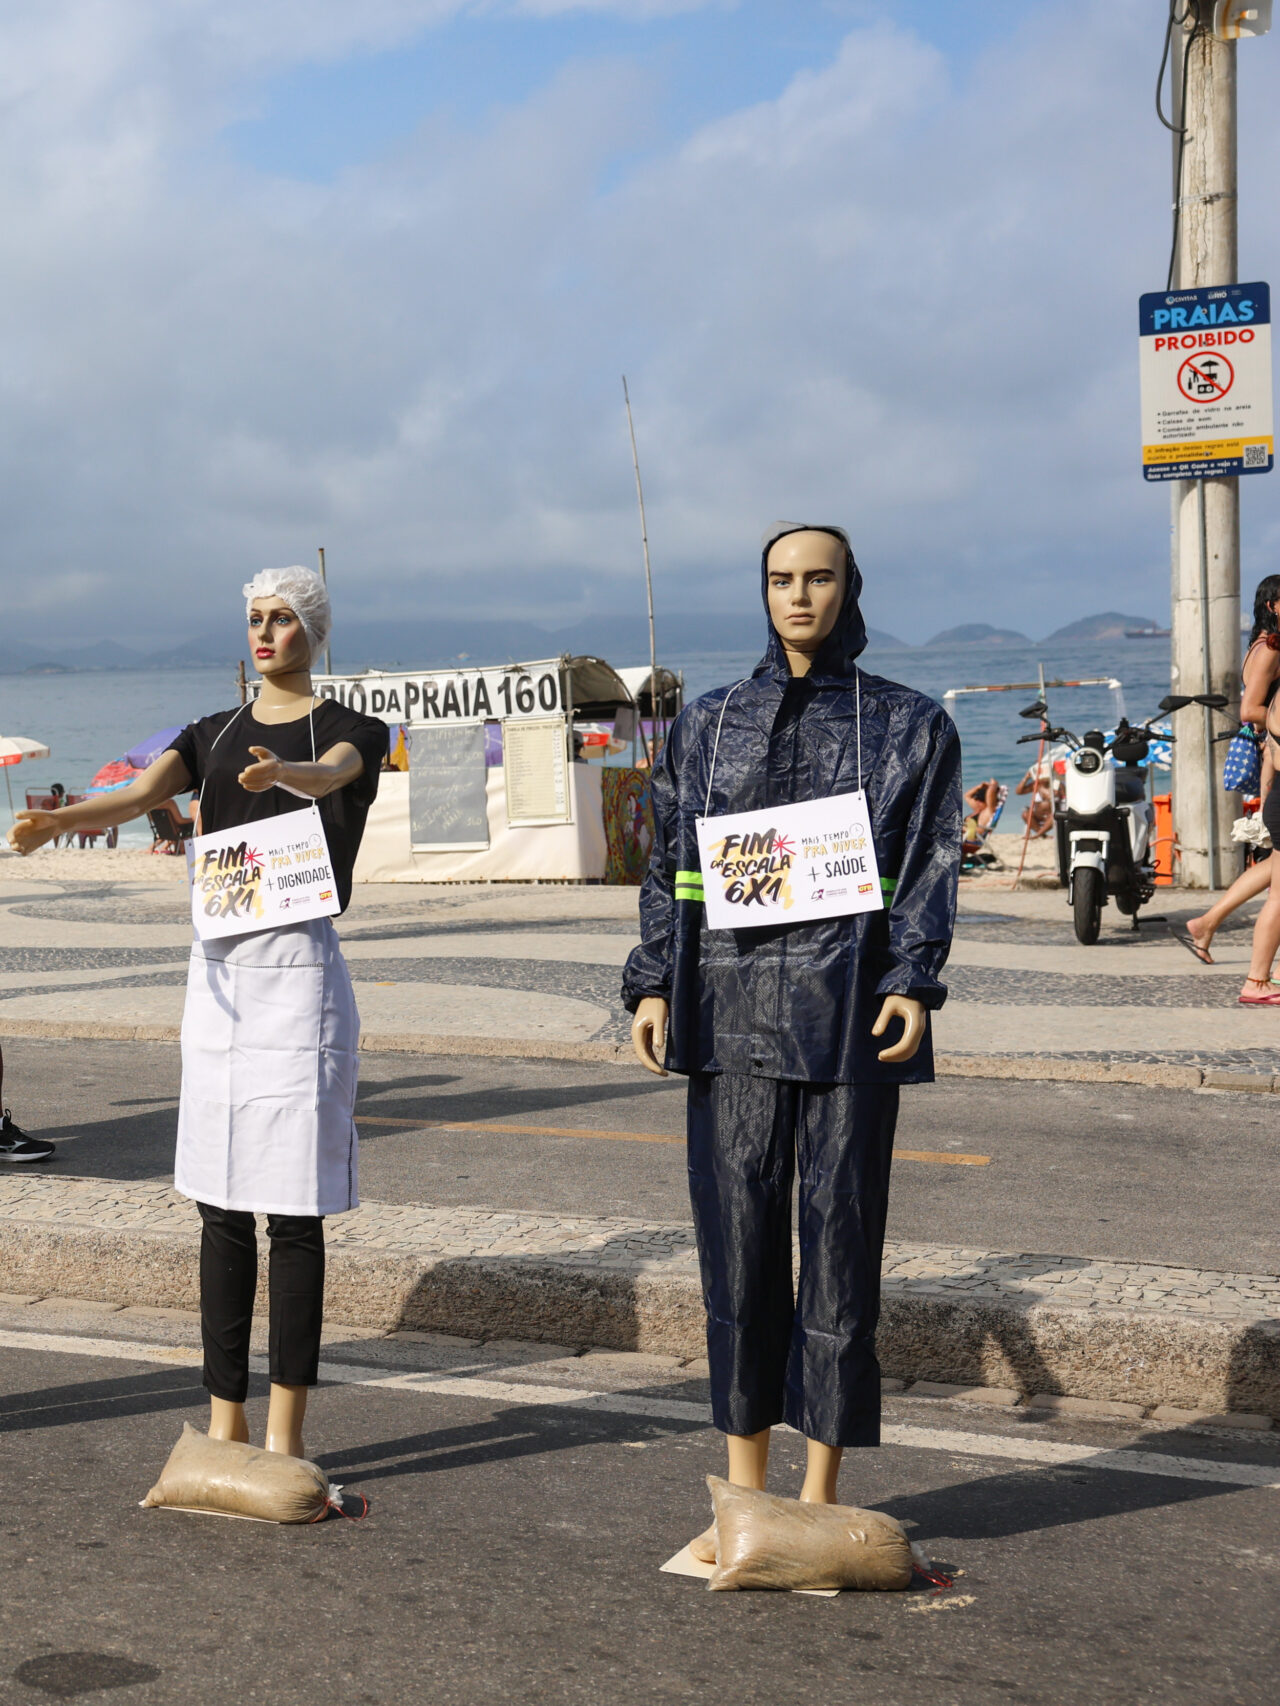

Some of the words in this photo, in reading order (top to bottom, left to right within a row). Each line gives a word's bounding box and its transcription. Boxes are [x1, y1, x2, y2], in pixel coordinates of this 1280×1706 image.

[1153, 300, 1255, 330] PRAIAS
[1154, 328, 1255, 352] PROIBIDO
[1162, 409, 1188, 417] Garrafas
[1162, 431, 1195, 439] autorizado
[1196, 422, 1228, 430] ambulante
[371, 689, 401, 713] DA
[404, 677, 492, 719] PRAIA
[497, 673, 557, 714] 160
[269, 847, 284, 856] MAIS
[287, 841, 309, 853] TEMPO
[721, 827, 777, 859] FIM
[801, 836, 819, 845] MAIS
[824, 830, 849, 842] TEMPO
[803, 844, 828, 859] PRA
[832, 837, 867, 854] VIVER
[202, 841, 247, 874] FIM
[271, 855, 292, 870] PRA
[295, 847, 325, 863] VIVER
[710, 859, 724, 870] DA
[721, 854, 791, 878] ESCALA
[825, 855, 867, 878] SAÚDE
[202, 866, 261, 893] ESCALA
[277, 865, 331, 890] DIGNIDADE
[724, 874, 784, 907] 6X1
[204, 887, 254, 919] 6X1
